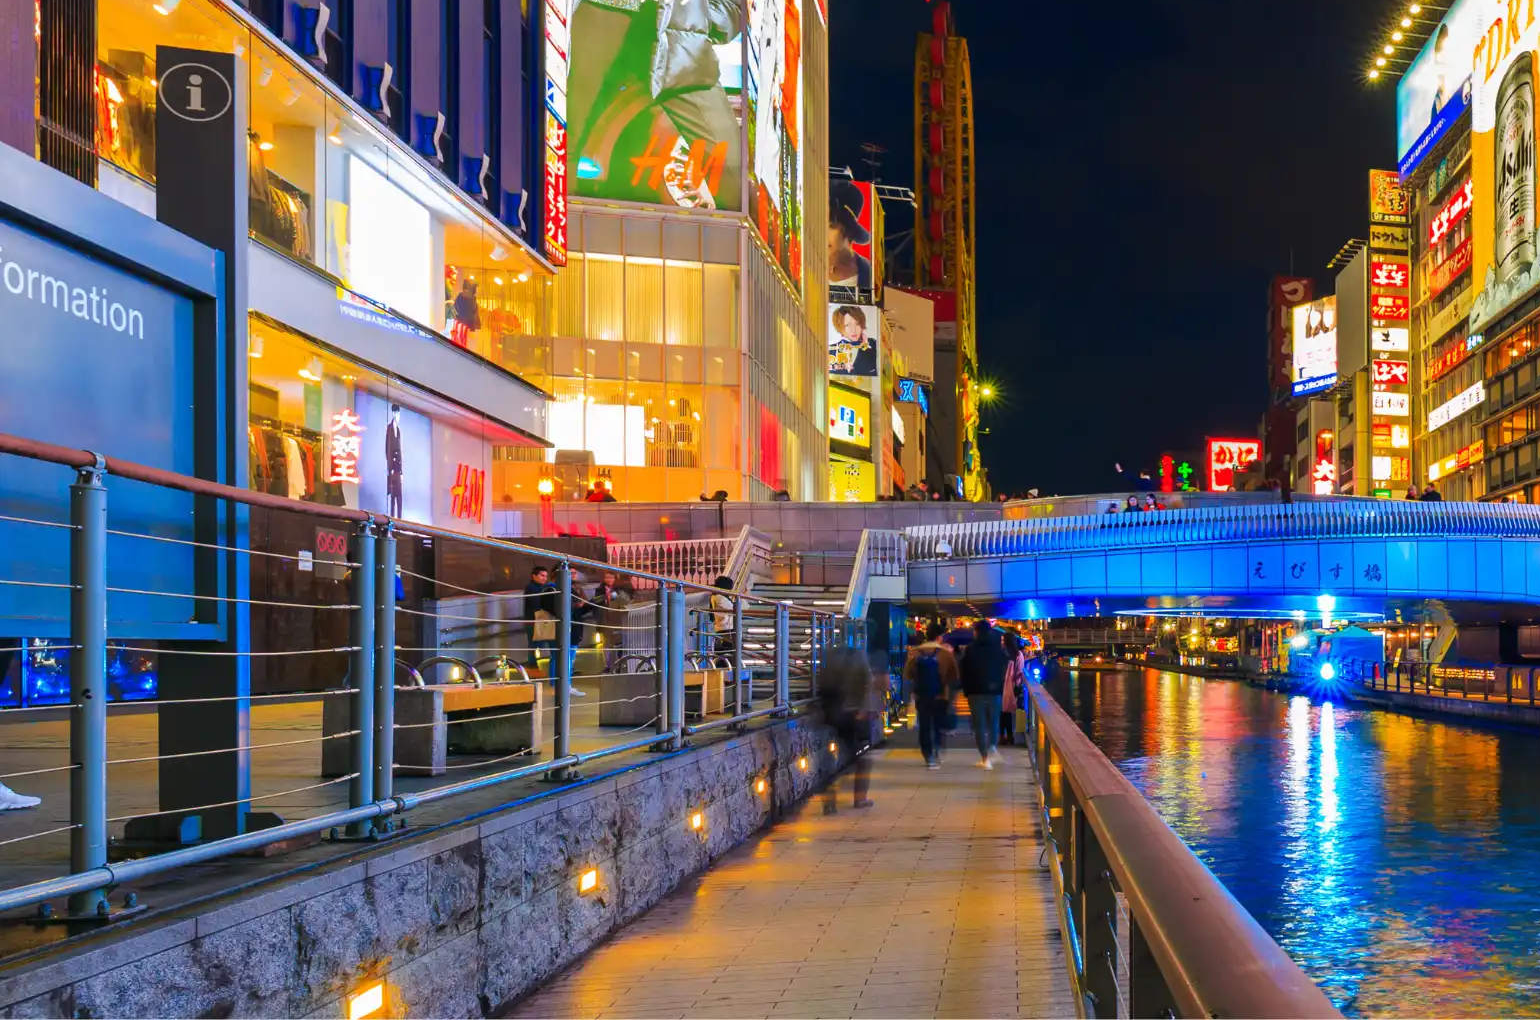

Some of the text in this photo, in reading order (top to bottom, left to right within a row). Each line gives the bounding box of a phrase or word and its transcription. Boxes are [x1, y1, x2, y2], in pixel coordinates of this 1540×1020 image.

[1497, 130, 1532, 204] Asahi
[1508, 197, 1520, 221] 生
[1372, 305, 1408, 317] ダイニング
[1213, 445, 1255, 465] かに
[1374, 481, 1387, 489] 1F
[1253, 561, 1382, 582] えびす橋
